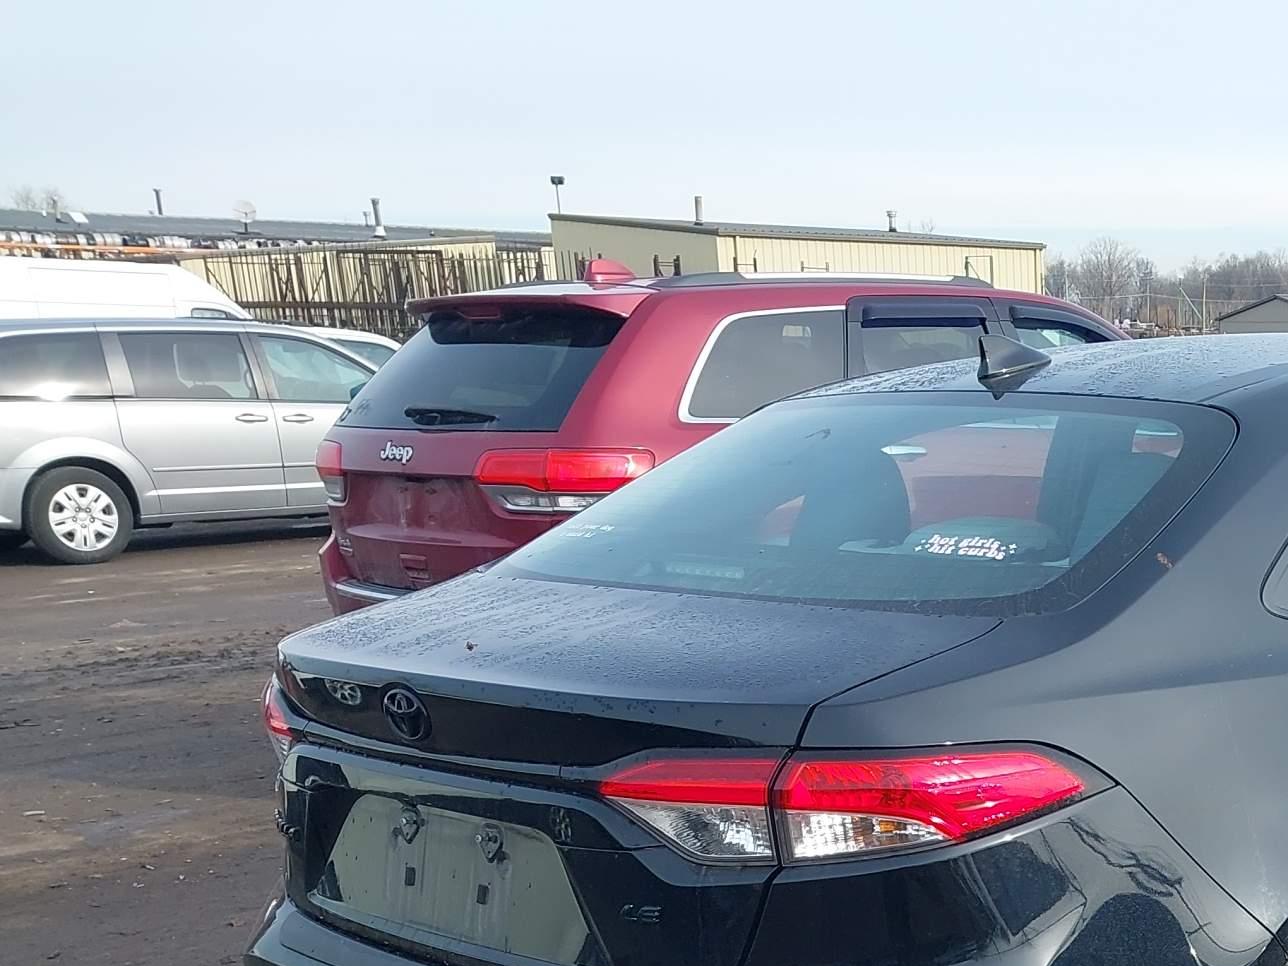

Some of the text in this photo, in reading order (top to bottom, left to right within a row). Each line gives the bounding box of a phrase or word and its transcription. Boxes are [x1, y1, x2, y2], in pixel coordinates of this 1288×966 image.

[380, 441, 413, 465] Jeep
[928, 533, 1001, 549] hot girls
[927, 543, 1006, 561] hit curbs
